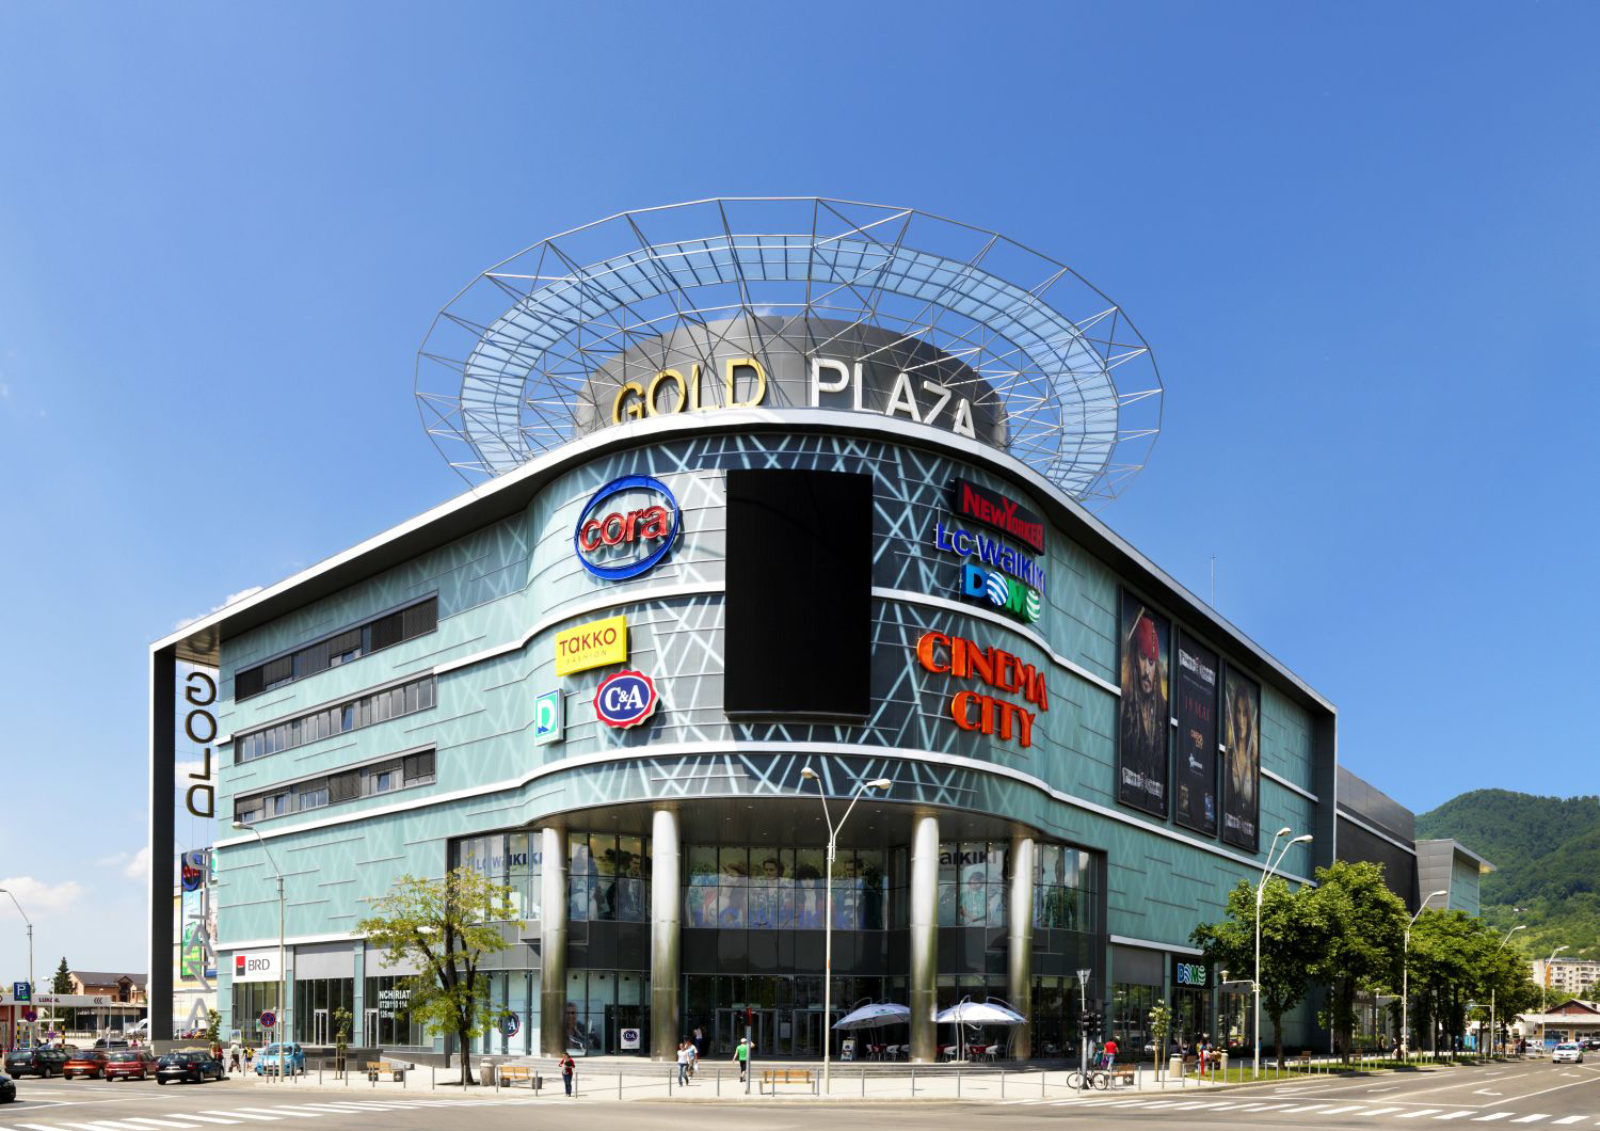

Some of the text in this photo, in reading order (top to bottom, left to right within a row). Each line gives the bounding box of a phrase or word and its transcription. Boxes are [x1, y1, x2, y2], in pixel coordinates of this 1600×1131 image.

[612, 357, 976, 439] GOLD PLAZA
[579, 504, 668, 552] cora
[604, 683, 644, 712] C&A
[917, 631, 1048, 712] CINEMA
[951, 690, 1036, 748] CITY
[248, 958, 270, 971] BRD
